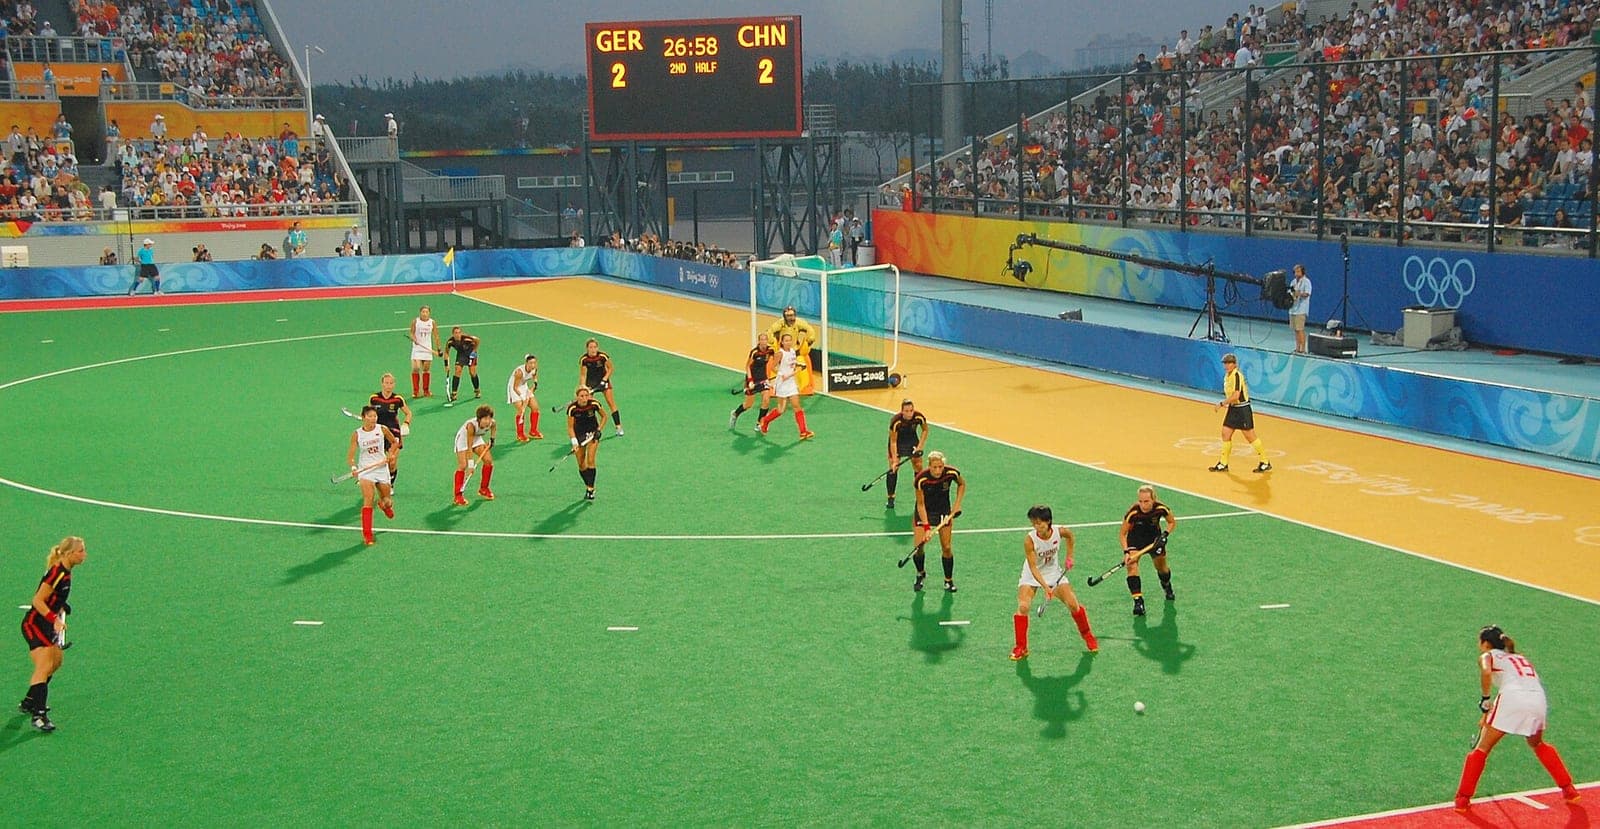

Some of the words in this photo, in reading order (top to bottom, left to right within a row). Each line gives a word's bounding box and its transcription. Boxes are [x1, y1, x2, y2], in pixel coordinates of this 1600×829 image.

[596, 30, 644, 52] GER
[664, 37, 719, 57] 26:58
[737, 25, 787, 48] CHN
[611, 63, 626, 88] 2
[669, 62, 687, 74] 2ND
[695, 62, 718, 73] HALF
[758, 58, 774, 84] 2
[831, 371, 862, 385] Beijing
[863, 371, 885, 382] 2008
[1509, 657, 1536, 677] 15
